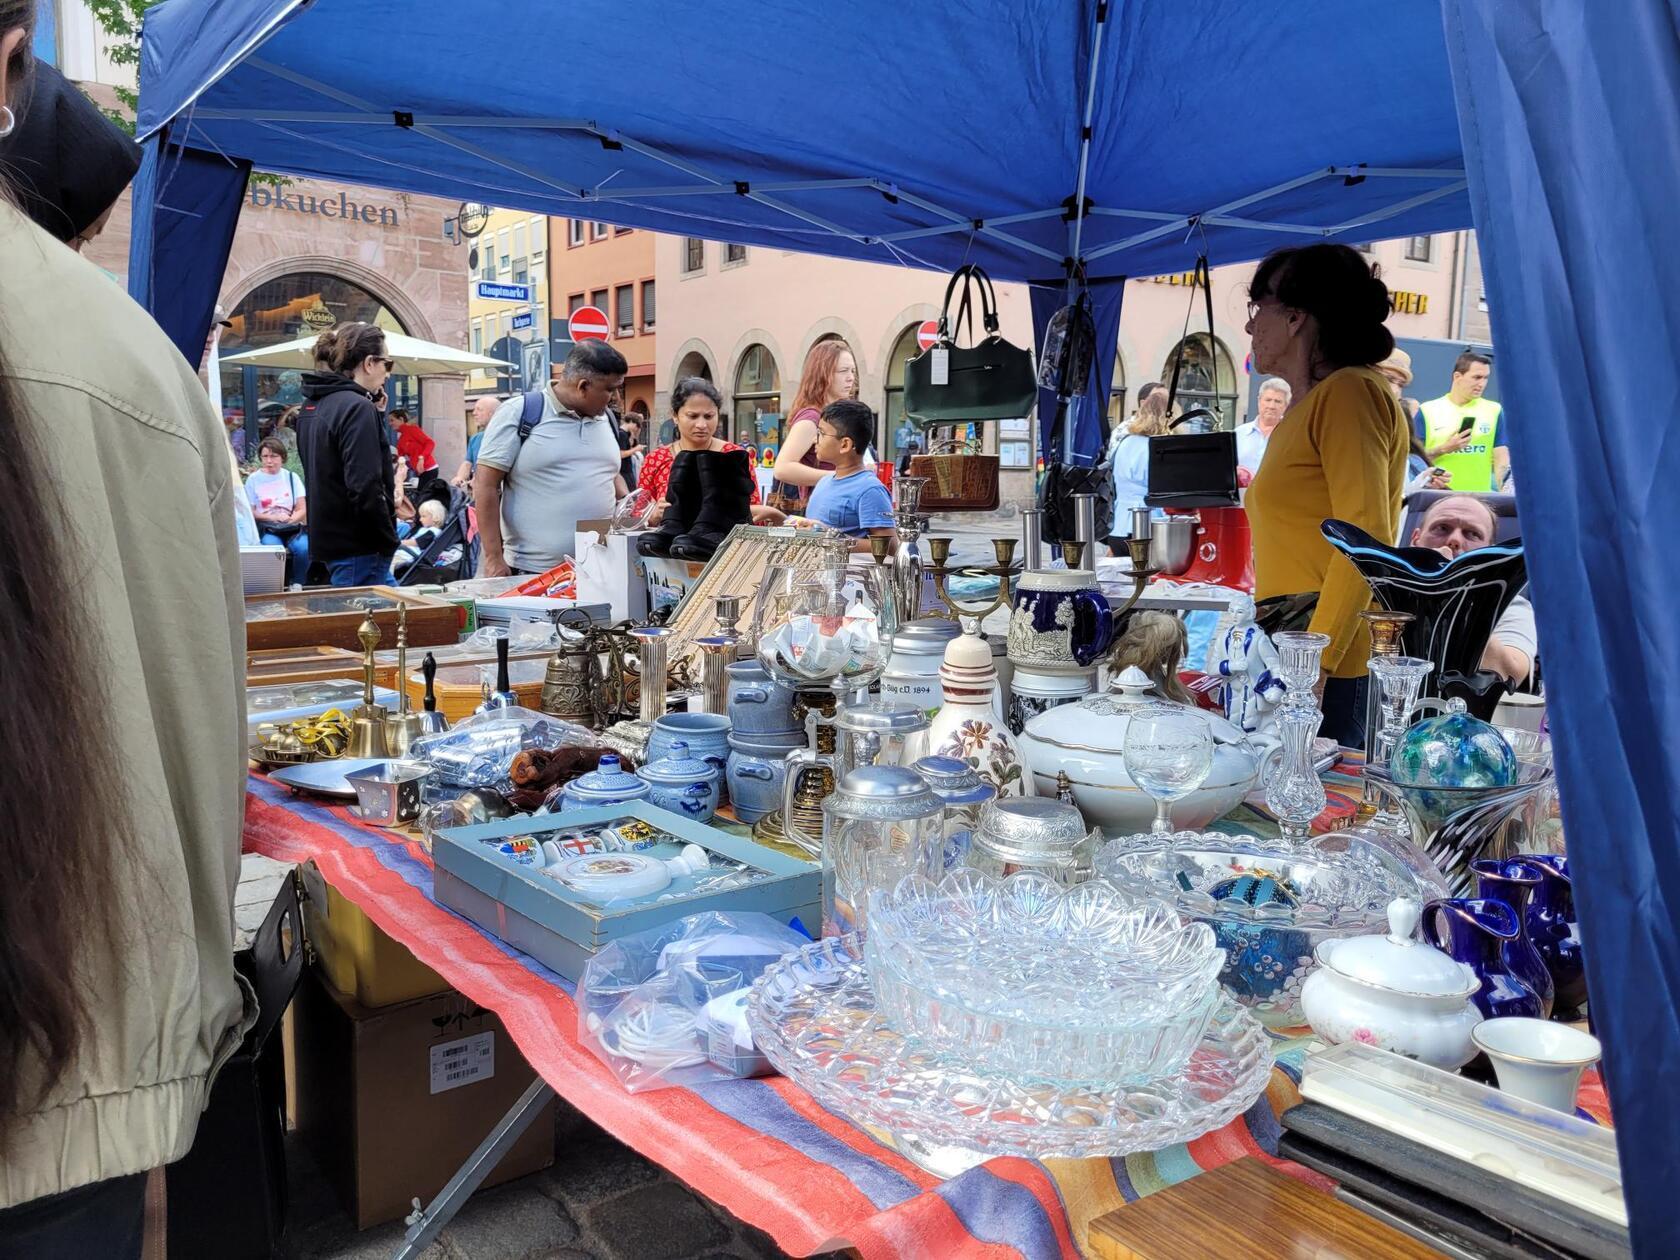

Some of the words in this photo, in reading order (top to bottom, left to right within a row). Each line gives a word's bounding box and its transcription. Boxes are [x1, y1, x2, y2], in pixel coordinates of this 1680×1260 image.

[244, 182, 400, 226] bkuchen
[1389, 290, 1428, 315] HER
[913, 686, 930, 694] 1894
